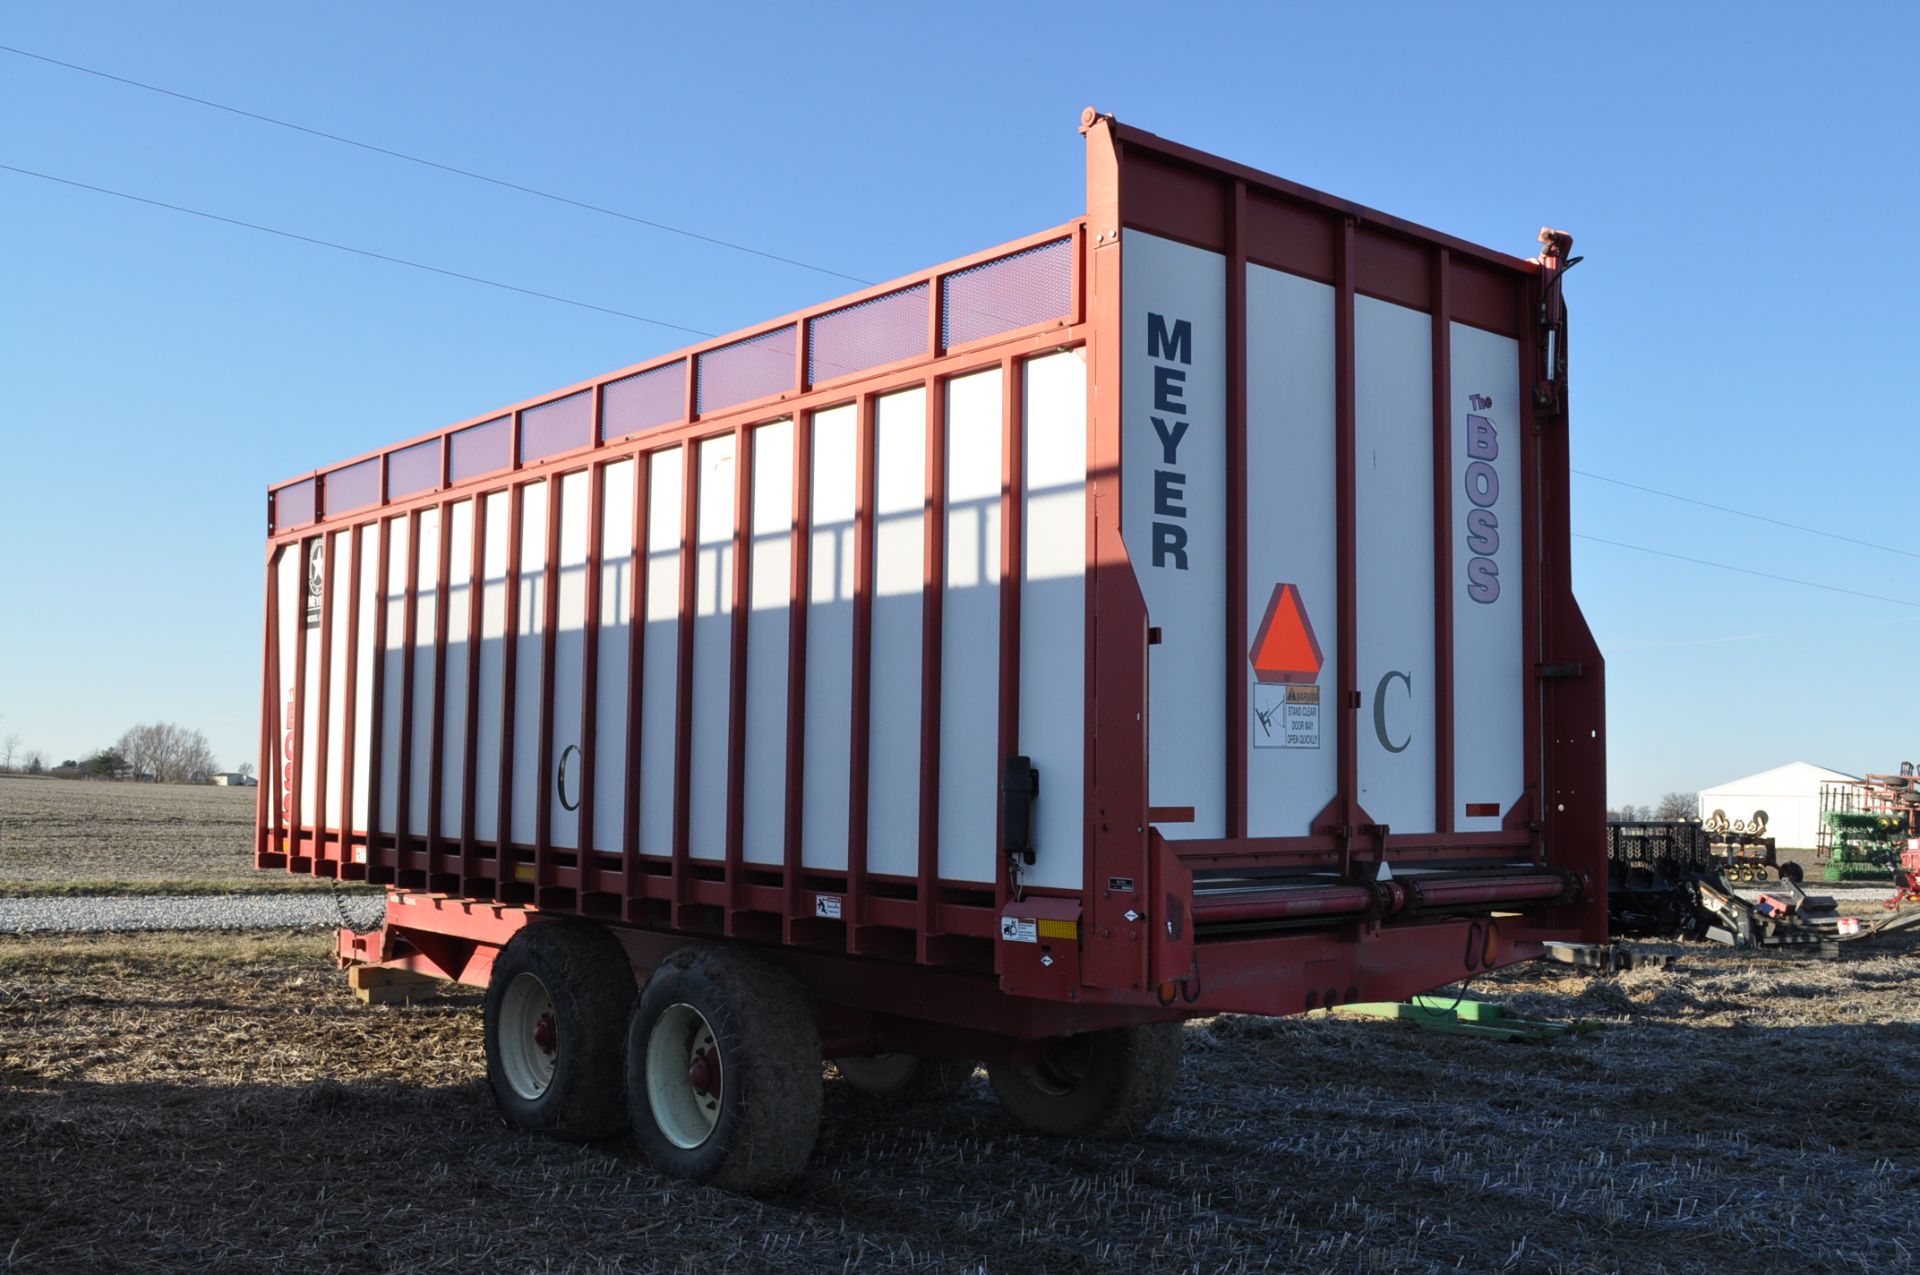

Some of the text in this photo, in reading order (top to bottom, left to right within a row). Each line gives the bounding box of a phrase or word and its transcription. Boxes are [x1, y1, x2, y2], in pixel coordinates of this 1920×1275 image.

[1469, 393, 1493, 411] The
[1148, 312, 1192, 570] MEYER
[1465, 413, 1500, 604] BOSS
[1288, 706, 1317, 717] STAND CLEAR
[1292, 720, 1304, 730] DOOR
[1374, 670, 1411, 753] C
